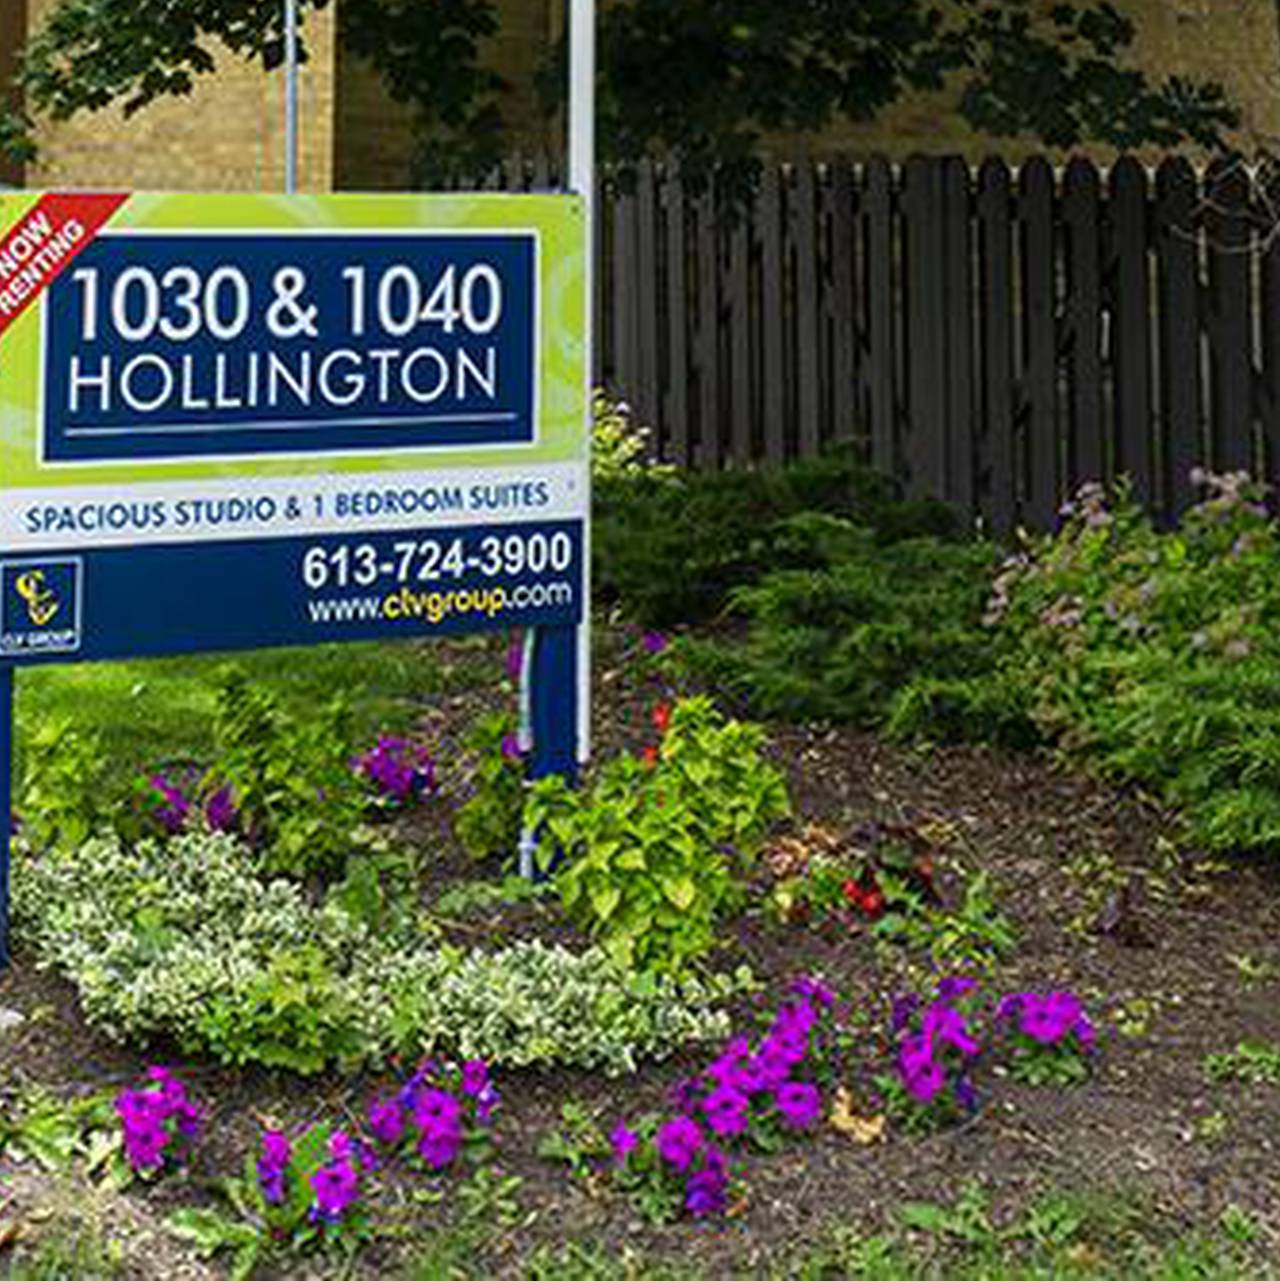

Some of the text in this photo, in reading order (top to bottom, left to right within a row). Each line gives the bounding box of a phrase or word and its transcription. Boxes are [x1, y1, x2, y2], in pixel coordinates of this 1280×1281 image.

[73, 263, 502, 341] 1030 & 1040
[69, 346, 497, 412] HOLLINGTON
[25, 481, 550, 533] SPACIOUS STUDIO & 1 BEDROOM SUITES
[303, 531, 571, 589] 613-724-3900
[308, 581, 572, 624] www.clvgroup.com
